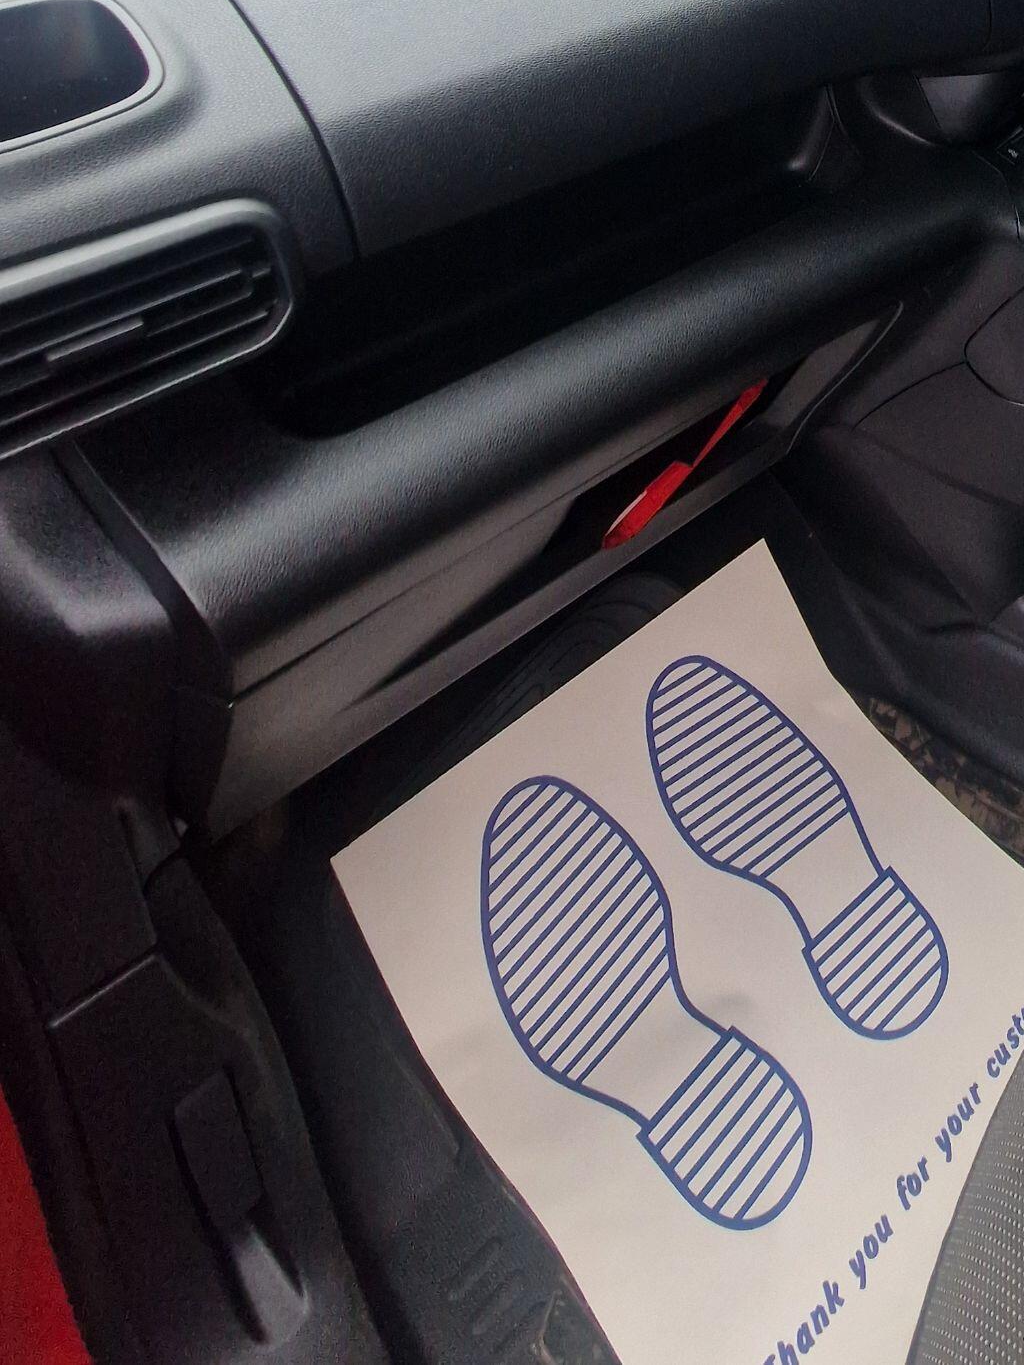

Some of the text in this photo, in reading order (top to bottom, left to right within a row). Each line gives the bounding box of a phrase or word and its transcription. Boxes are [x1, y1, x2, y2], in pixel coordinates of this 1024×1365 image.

[762, 1280, 845, 1365] hank
[848, 1214, 895, 1290] you
[896, 1156, 930, 1211] for
[934, 1082, 983, 1164] your
